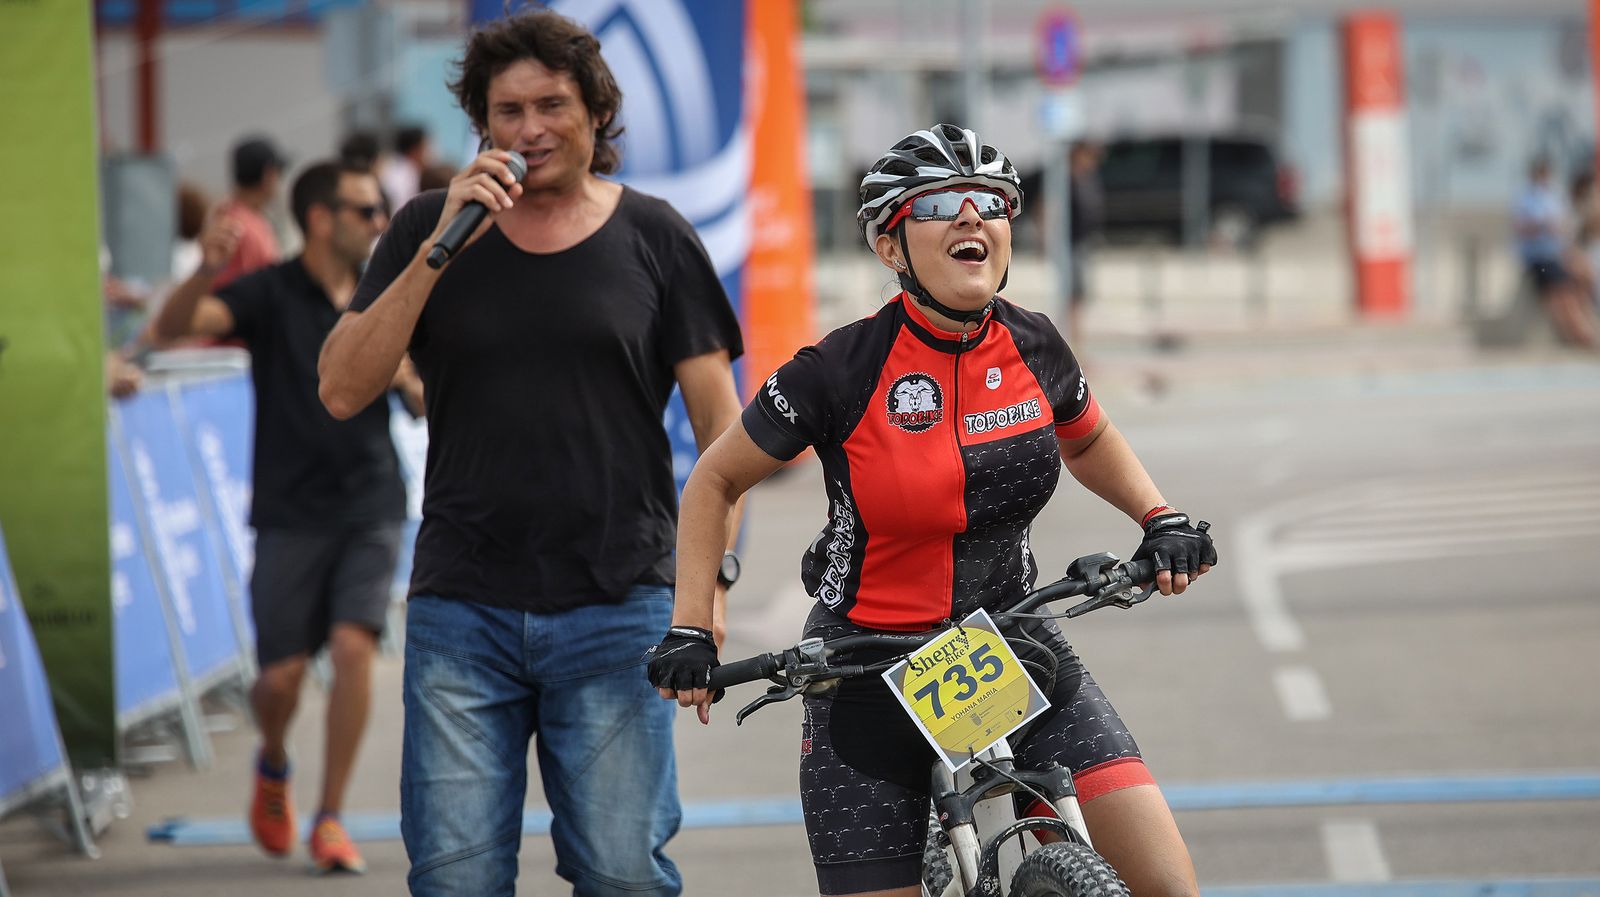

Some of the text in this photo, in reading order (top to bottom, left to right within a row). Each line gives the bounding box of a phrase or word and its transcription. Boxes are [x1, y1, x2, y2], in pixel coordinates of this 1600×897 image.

[766, 370, 799, 425] uvex
[886, 408, 944, 426] TODOBIKE
[964, 398, 1042, 434] TODOBIKE
[944, 648, 965, 666] Bike
[913, 642, 1004, 720] 735
[950, 701, 979, 721] YOHANA
[976, 687, 998, 705] MARIA
